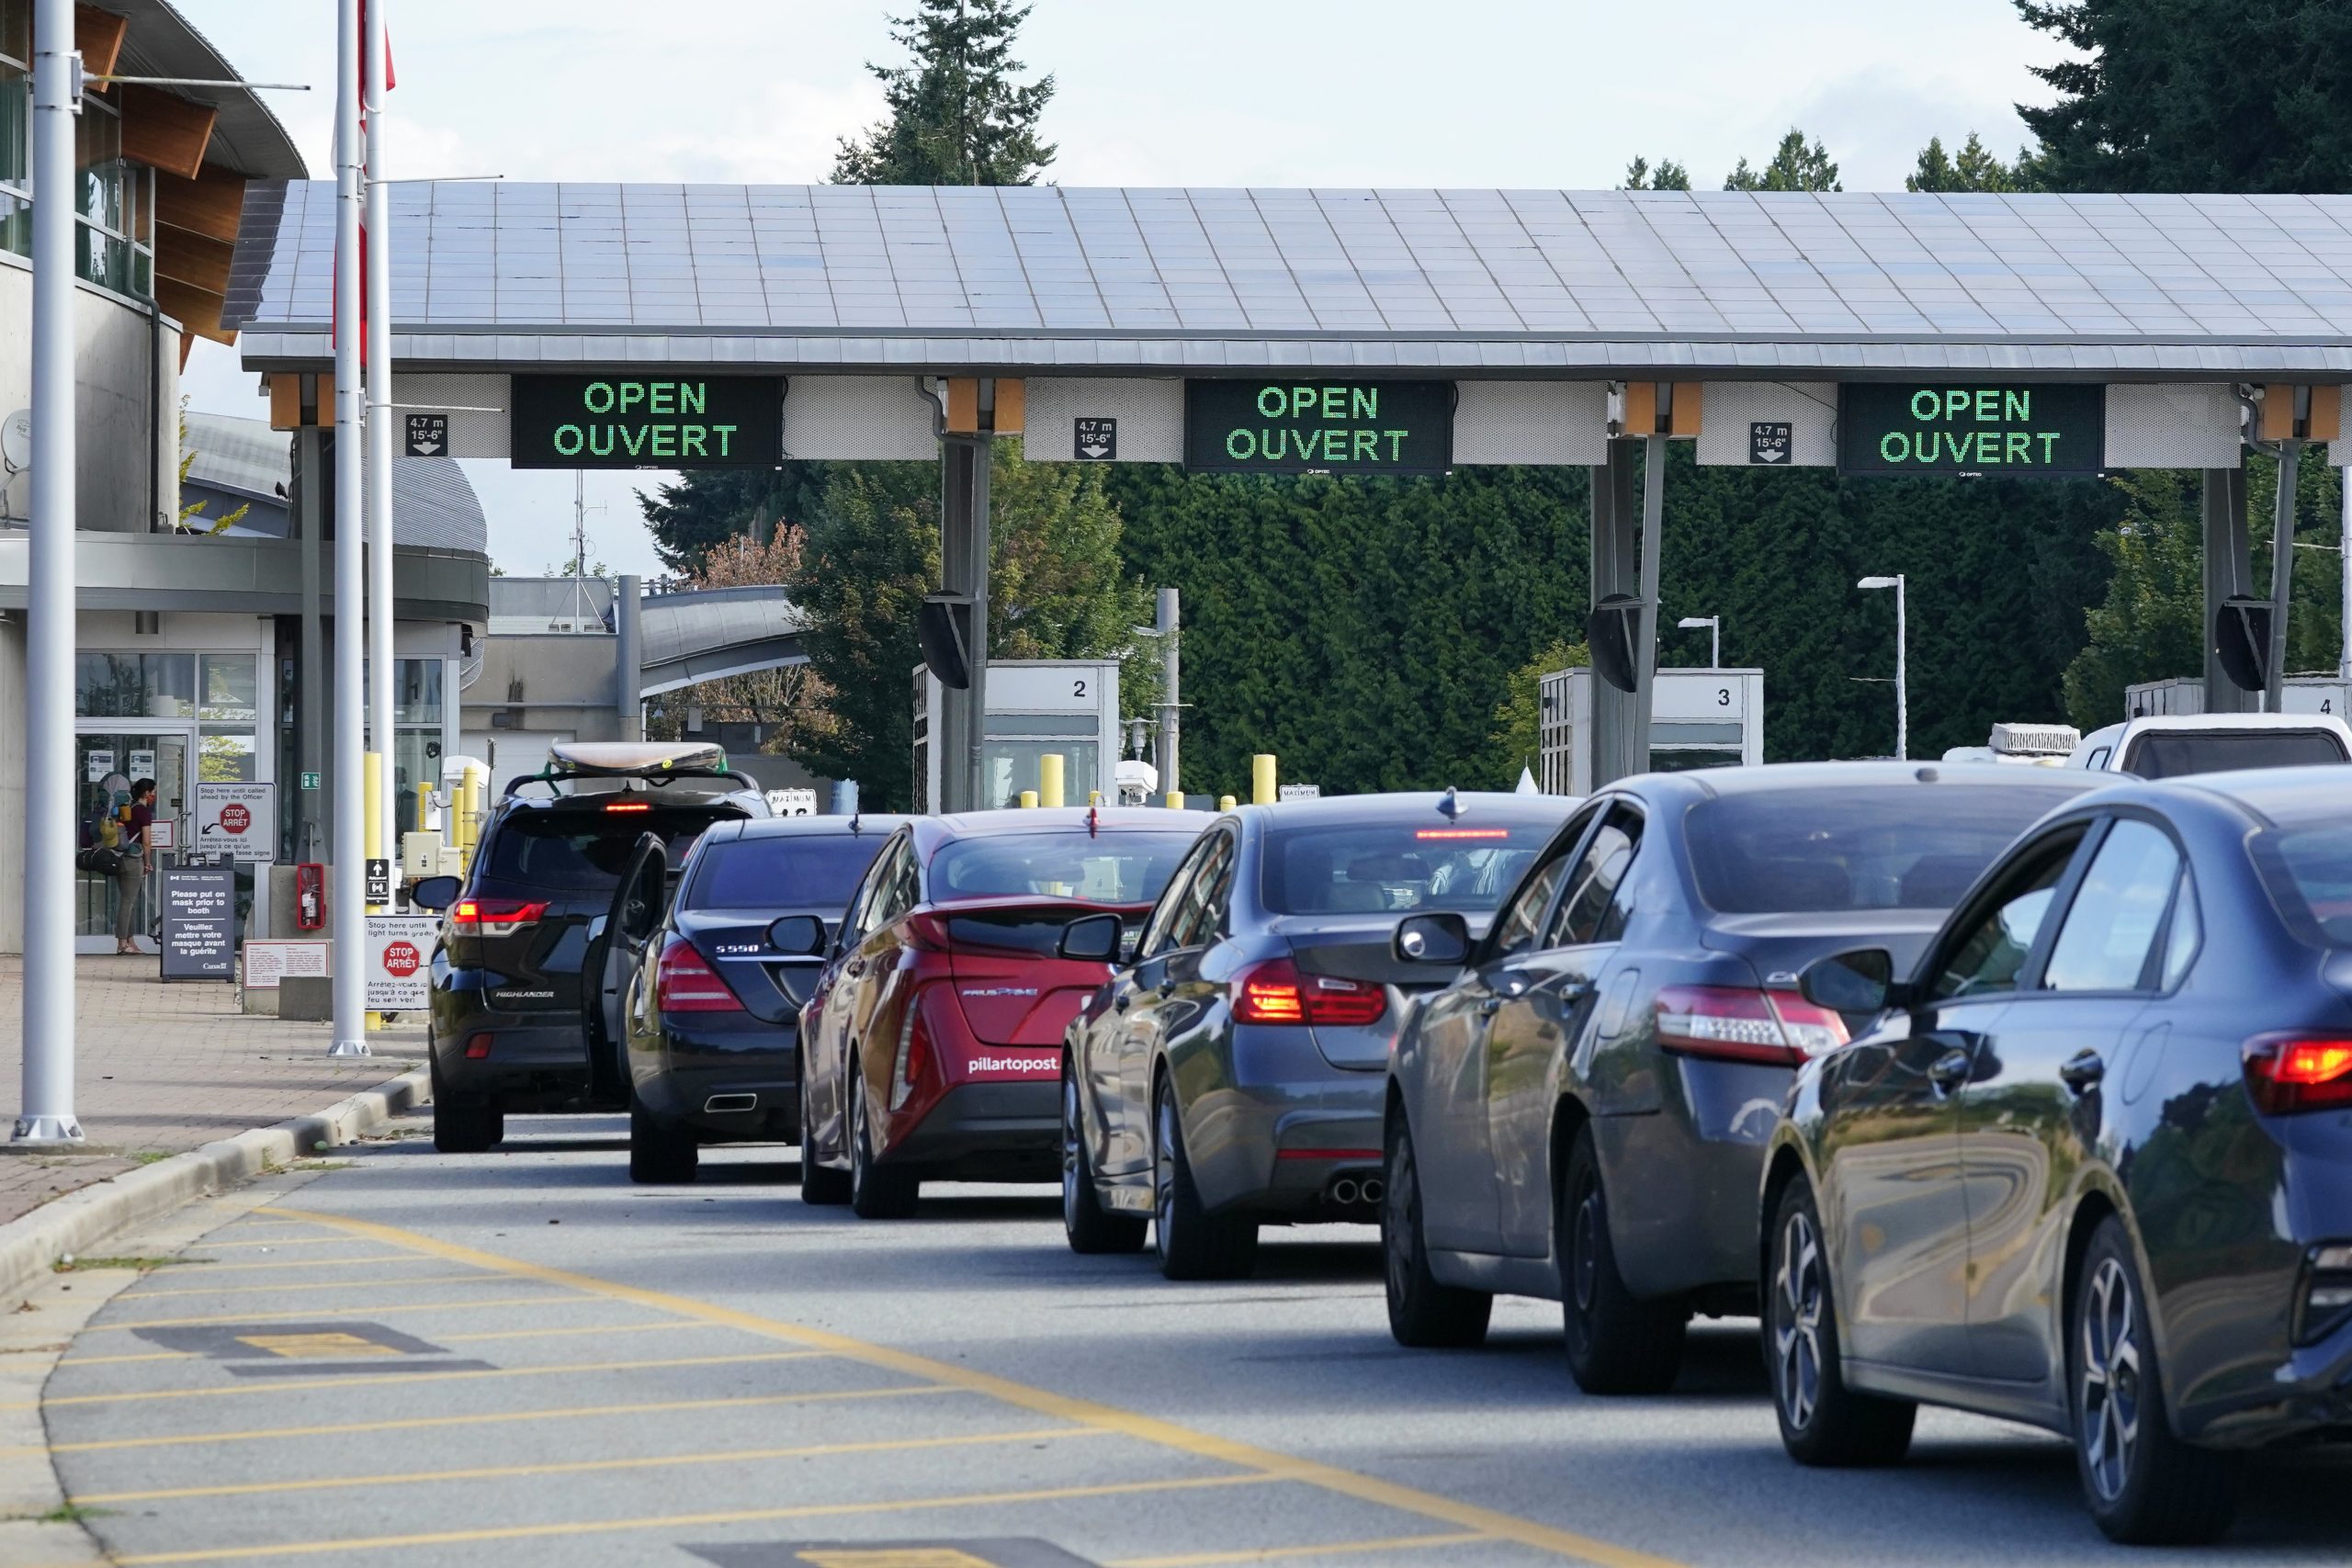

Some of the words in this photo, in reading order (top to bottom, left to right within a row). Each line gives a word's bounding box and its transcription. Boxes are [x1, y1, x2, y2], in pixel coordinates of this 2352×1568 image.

[583, 382, 706, 414] OPEN
[1257, 386, 1378, 419] OPEN
[1910, 389, 2030, 422] OPEN
[410, 418, 428, 427] 4.7
[1080, 422, 1097, 431] 4.7
[412, 430, 443, 440] 15'-6"
[1755, 425, 1772, 435] 4.7
[1777, 427, 1788, 435] m
[554, 424, 738, 457] OUVERT
[1080, 434, 1111, 443] 15'-6"
[1757, 438, 1786, 447] 15'-6"
[1226, 428, 1408, 461] OUVERT
[1880, 431, 2061, 464] OUVERT
[410, 683, 418, 699] 1
[1074, 681, 1086, 697] 2
[1718, 689, 1730, 706] 3
[2320, 699, 2331, 714] 4
[225, 809, 246, 818] STOP
[199, 890, 213, 899] put
[196, 898, 214, 907] prior
[171, 940, 202, 948] masque
[189, 947, 217, 956] guérite
[390, 947, 414, 957] STOP
